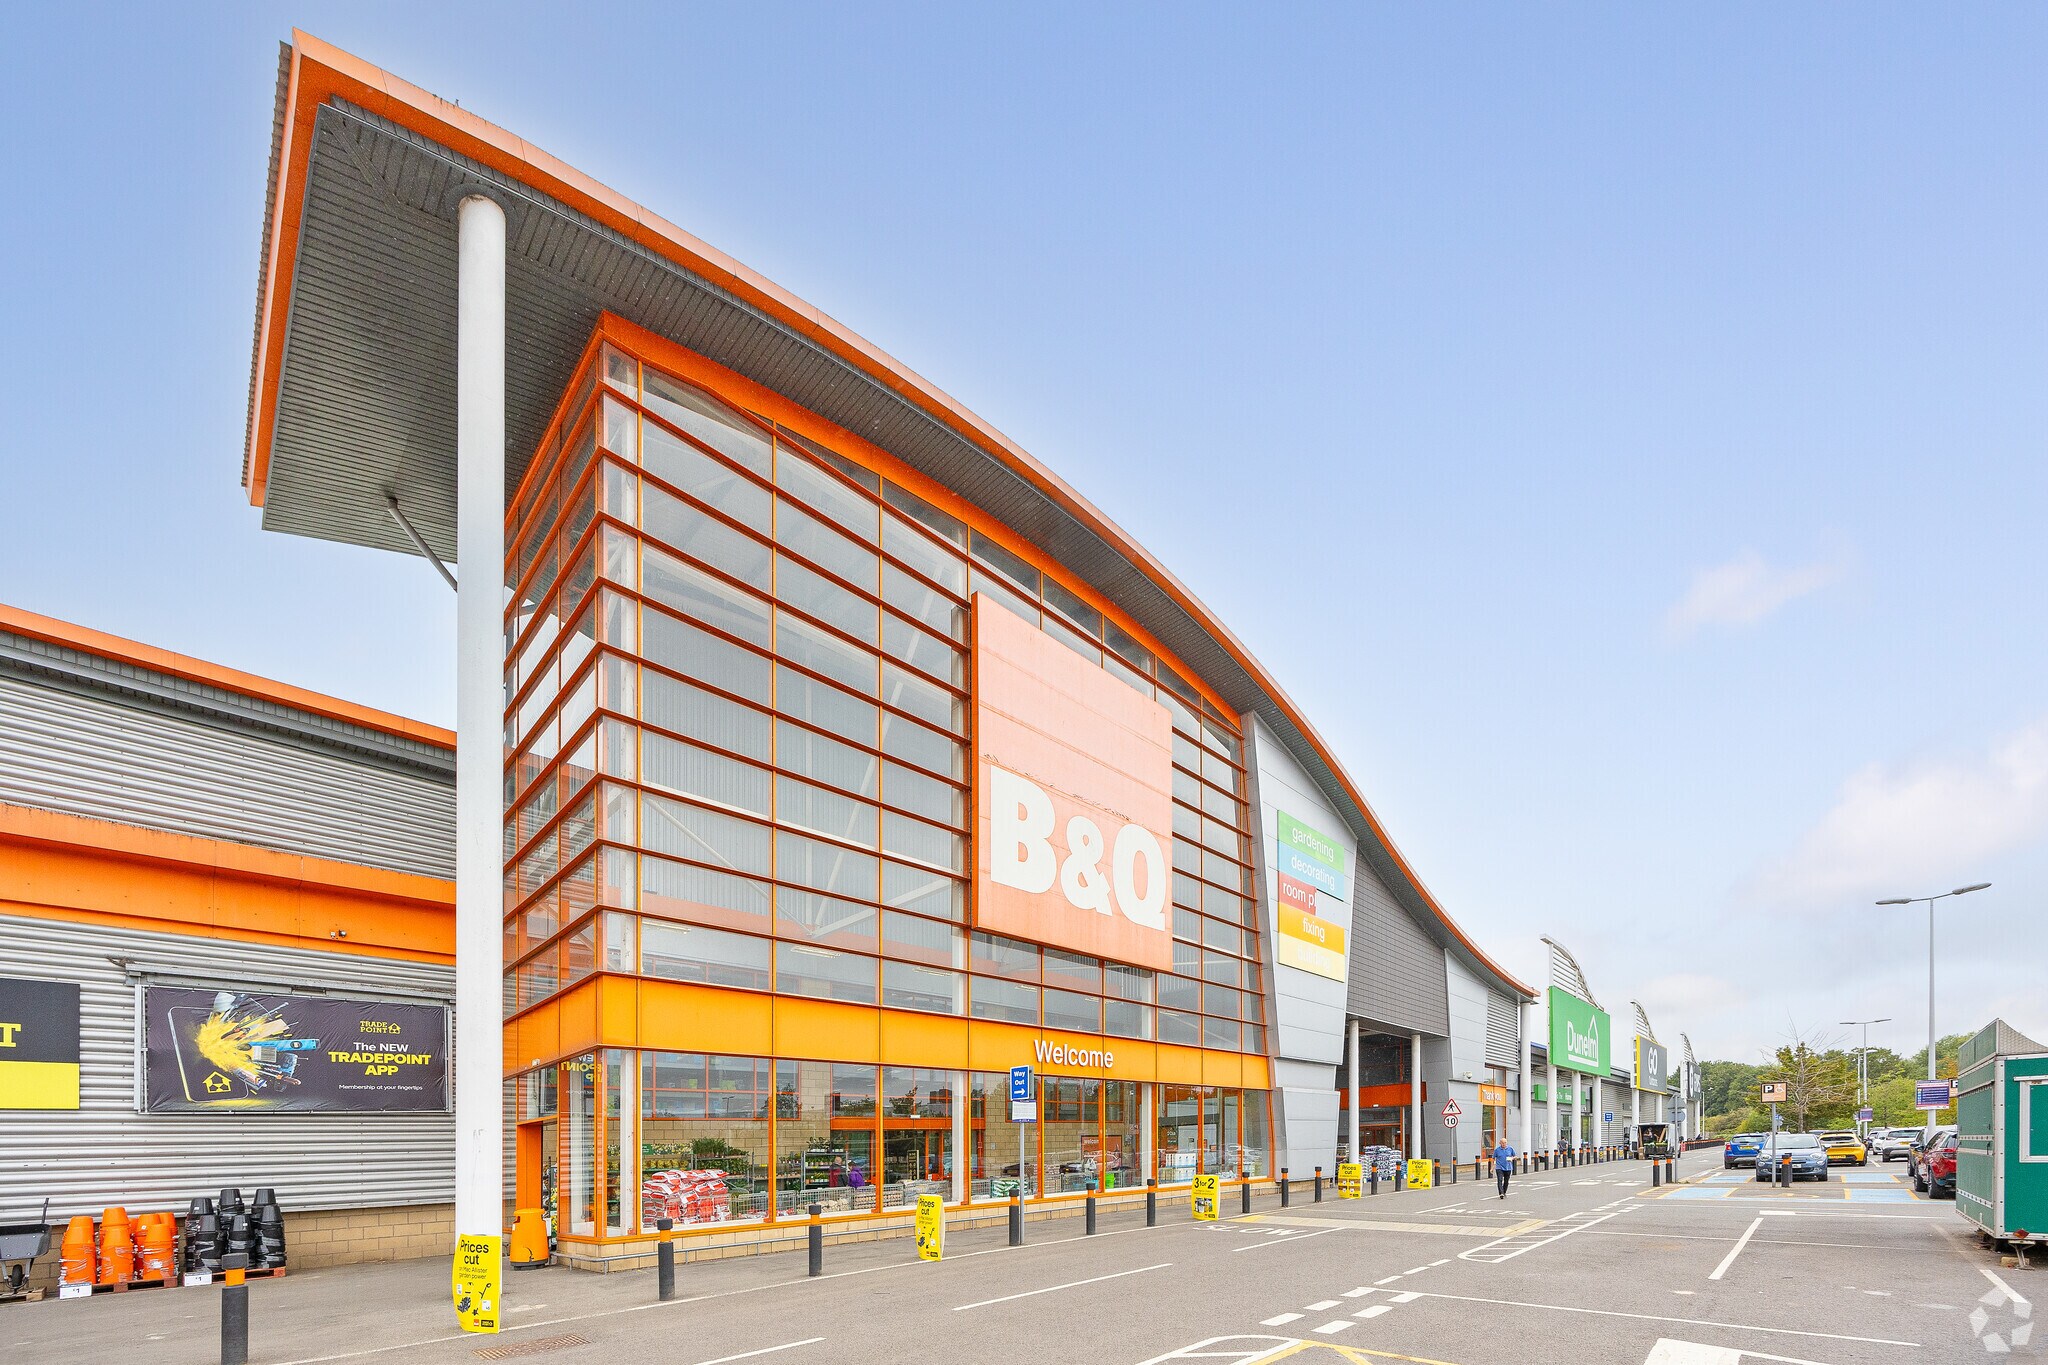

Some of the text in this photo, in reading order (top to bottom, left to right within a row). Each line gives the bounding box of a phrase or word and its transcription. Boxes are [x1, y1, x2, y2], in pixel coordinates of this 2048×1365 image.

[990, 764, 1167, 932] B&Q
[1292, 827, 1334, 862] gardening
[1291, 855, 1335, 890] decorating
[1282, 882, 1306, 903] room
[1302, 917, 1325, 943] fixing
[360, 1020, 388, 1028] TRADE
[1567, 1016, 1599, 1059] Dunelm
[353, 1042, 409, 1053] The NEW
[1034, 1040, 1114, 1068] Welcome
[328, 1051, 432, 1065] TRADEPOINT
[1647, 1046, 1658, 1076] GO
[364, 1065, 399, 1076] APP
[1013, 1070, 1026, 1078] Way
[1764, 1085, 1773, 1093] P
[1194, 1177, 1200, 1188] 3
[1207, 1178, 1214, 1189] 2
[919, 1198, 935, 1208] Prices
[460, 1239, 489, 1254] Prices
[464, 1254, 479, 1265] cut
